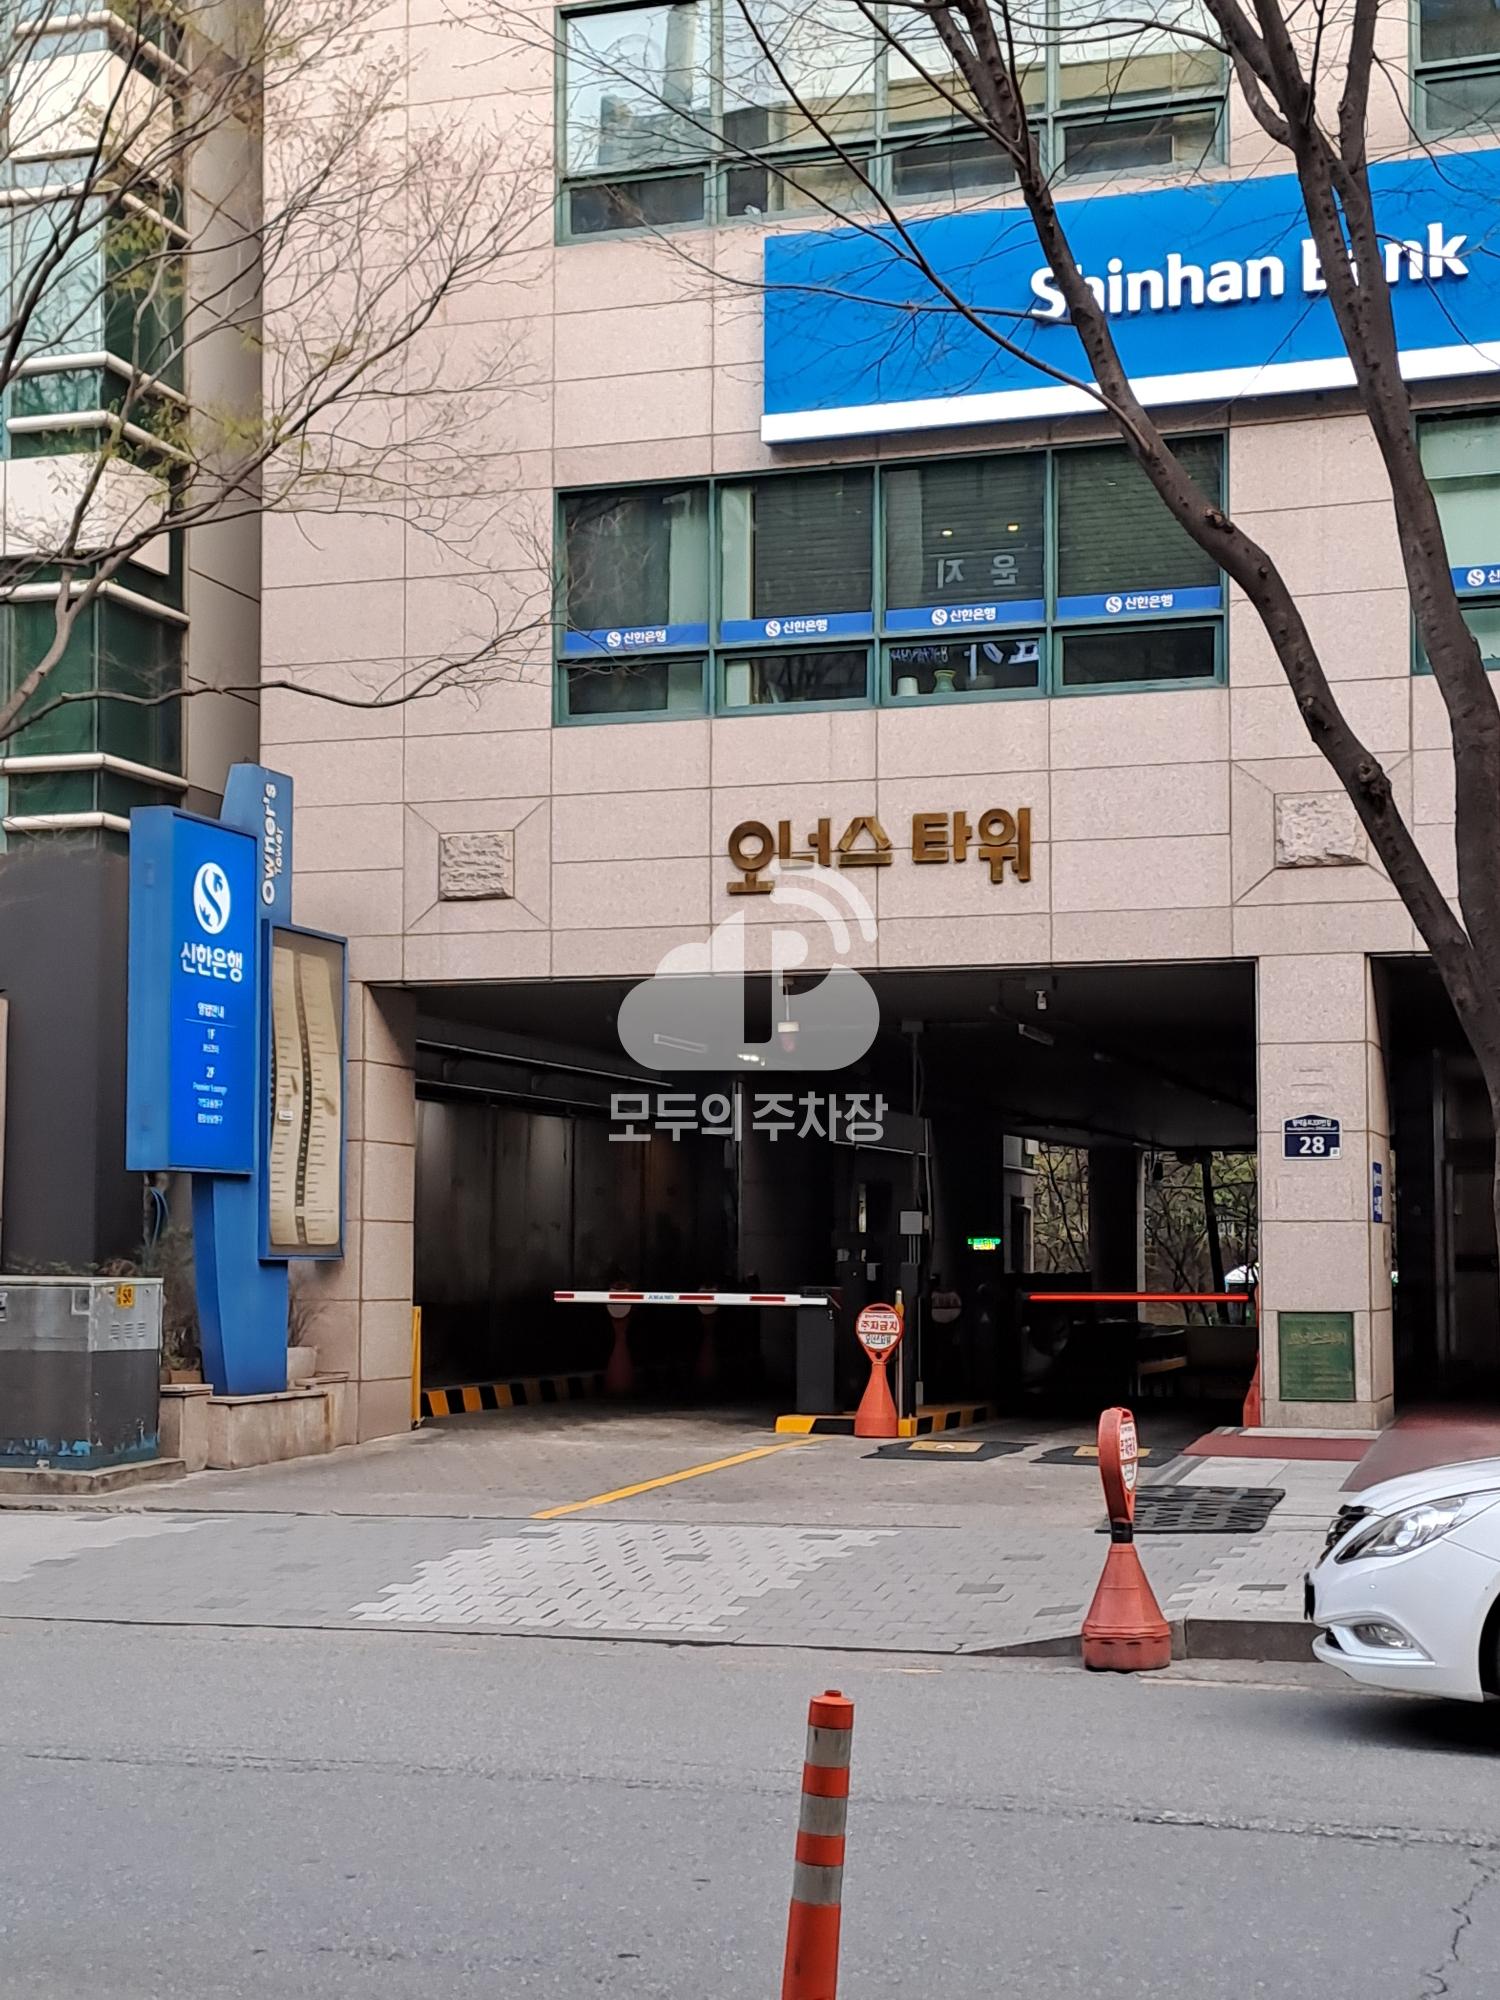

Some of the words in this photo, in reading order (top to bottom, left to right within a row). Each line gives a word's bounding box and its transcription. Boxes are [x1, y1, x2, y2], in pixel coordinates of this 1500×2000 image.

[1302, 222, 1469, 292] Bnk
[1125, 593, 1173, 610] 신한은행
[950, 607, 996, 622] 신한은행
[783, 619, 828, 634] 신한은행
[262, 784, 277, 905] Owner's
[275, 827, 284, 875] Tower
[727, 816, 892, 895] 오너스
[912, 808, 1031, 883] 타워
[180, 941, 242, 983] 신한은행
[207, 1028, 216, 1040] 1F
[206, 1066, 215, 1078] 2F
[1299, 1136, 1325, 1154] 28
